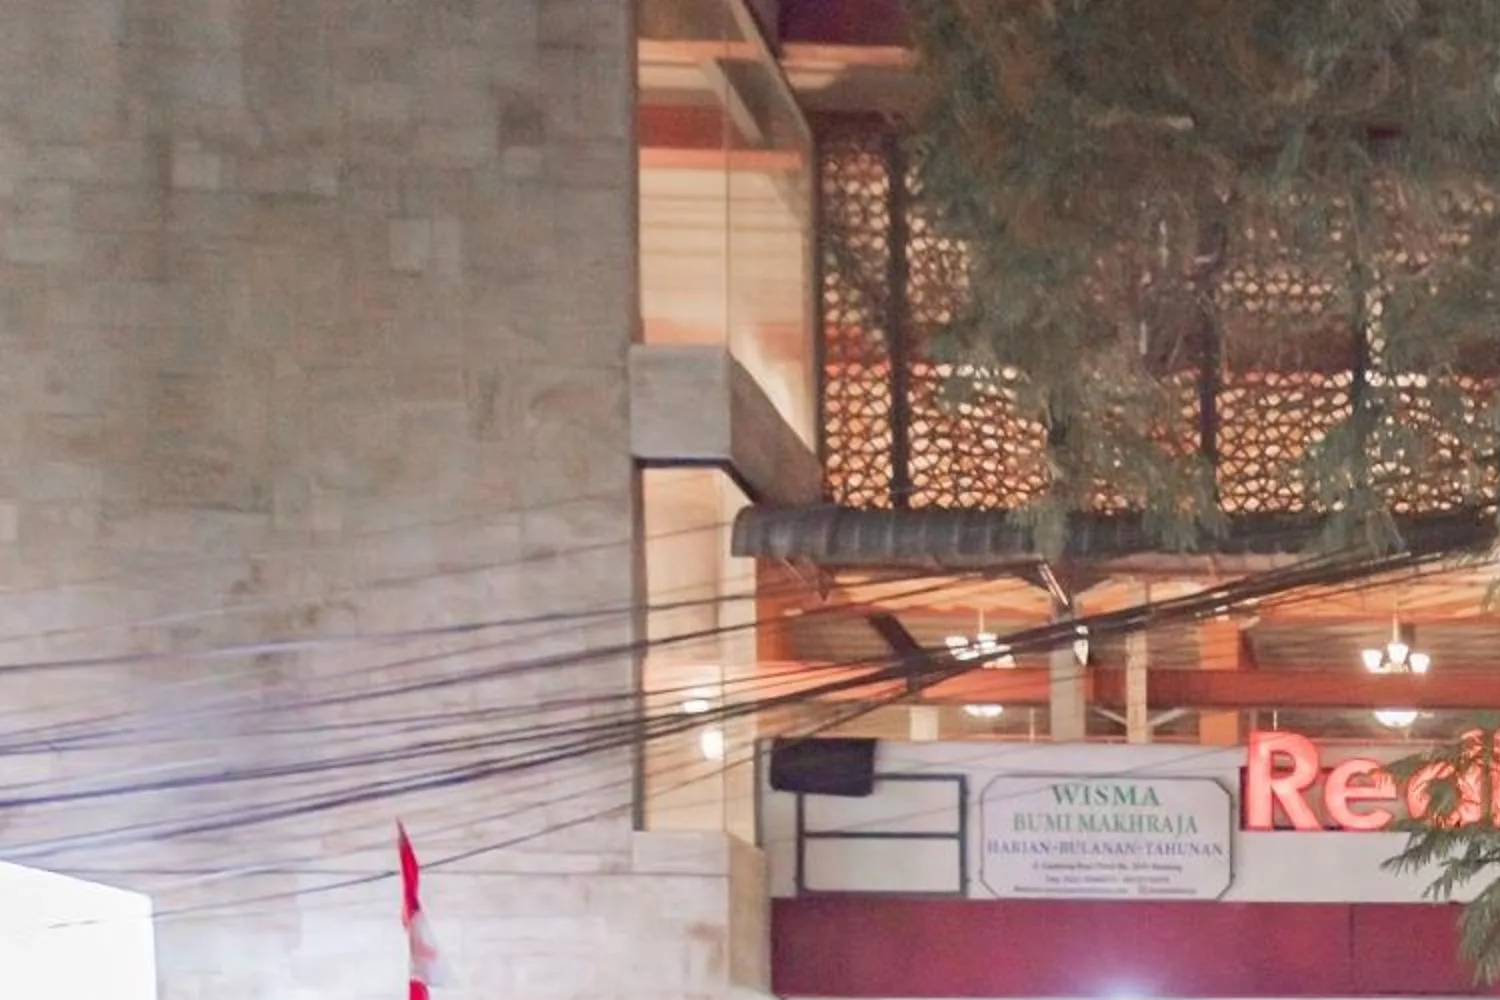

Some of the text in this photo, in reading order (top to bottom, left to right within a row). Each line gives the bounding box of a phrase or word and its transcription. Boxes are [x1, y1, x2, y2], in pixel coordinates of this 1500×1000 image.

[1051, 784, 1160, 807] WISMA
[1013, 812, 1198, 838] BUMI MAKHRAJA
